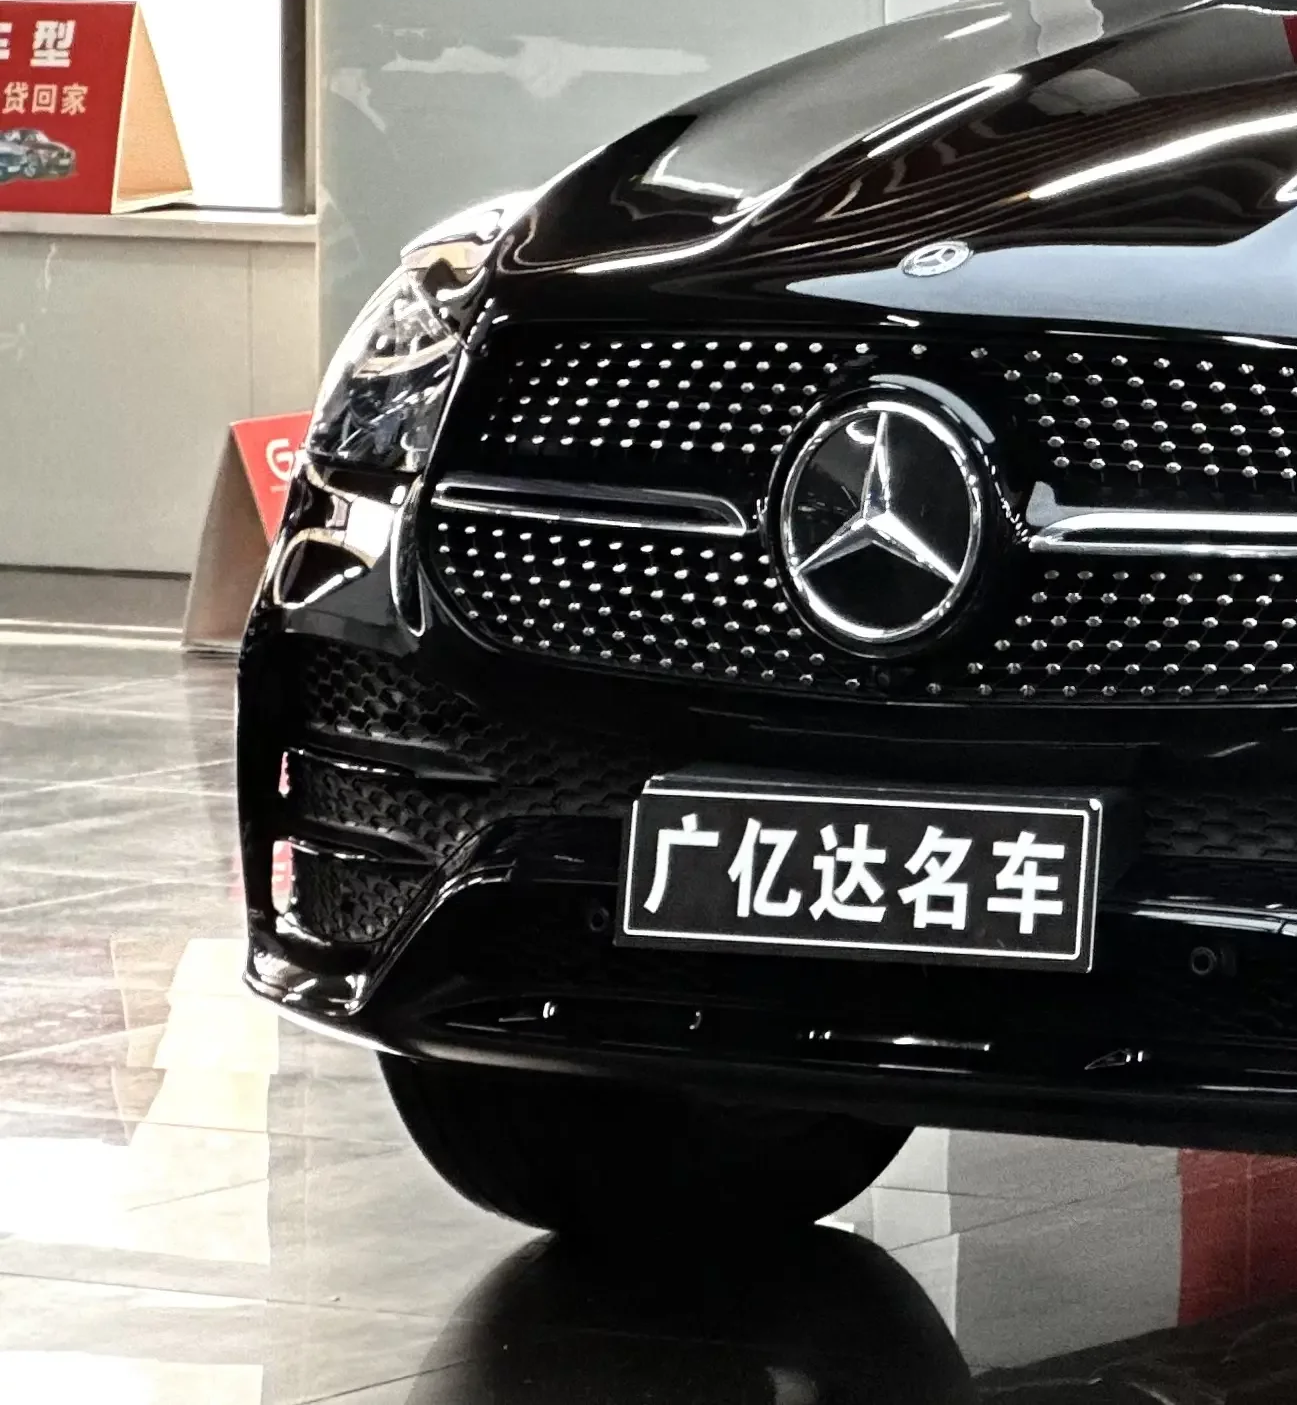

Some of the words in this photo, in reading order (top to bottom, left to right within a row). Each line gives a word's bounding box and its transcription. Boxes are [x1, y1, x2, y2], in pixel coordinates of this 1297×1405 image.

[643, 813, 1067, 935] 广亿达名车
